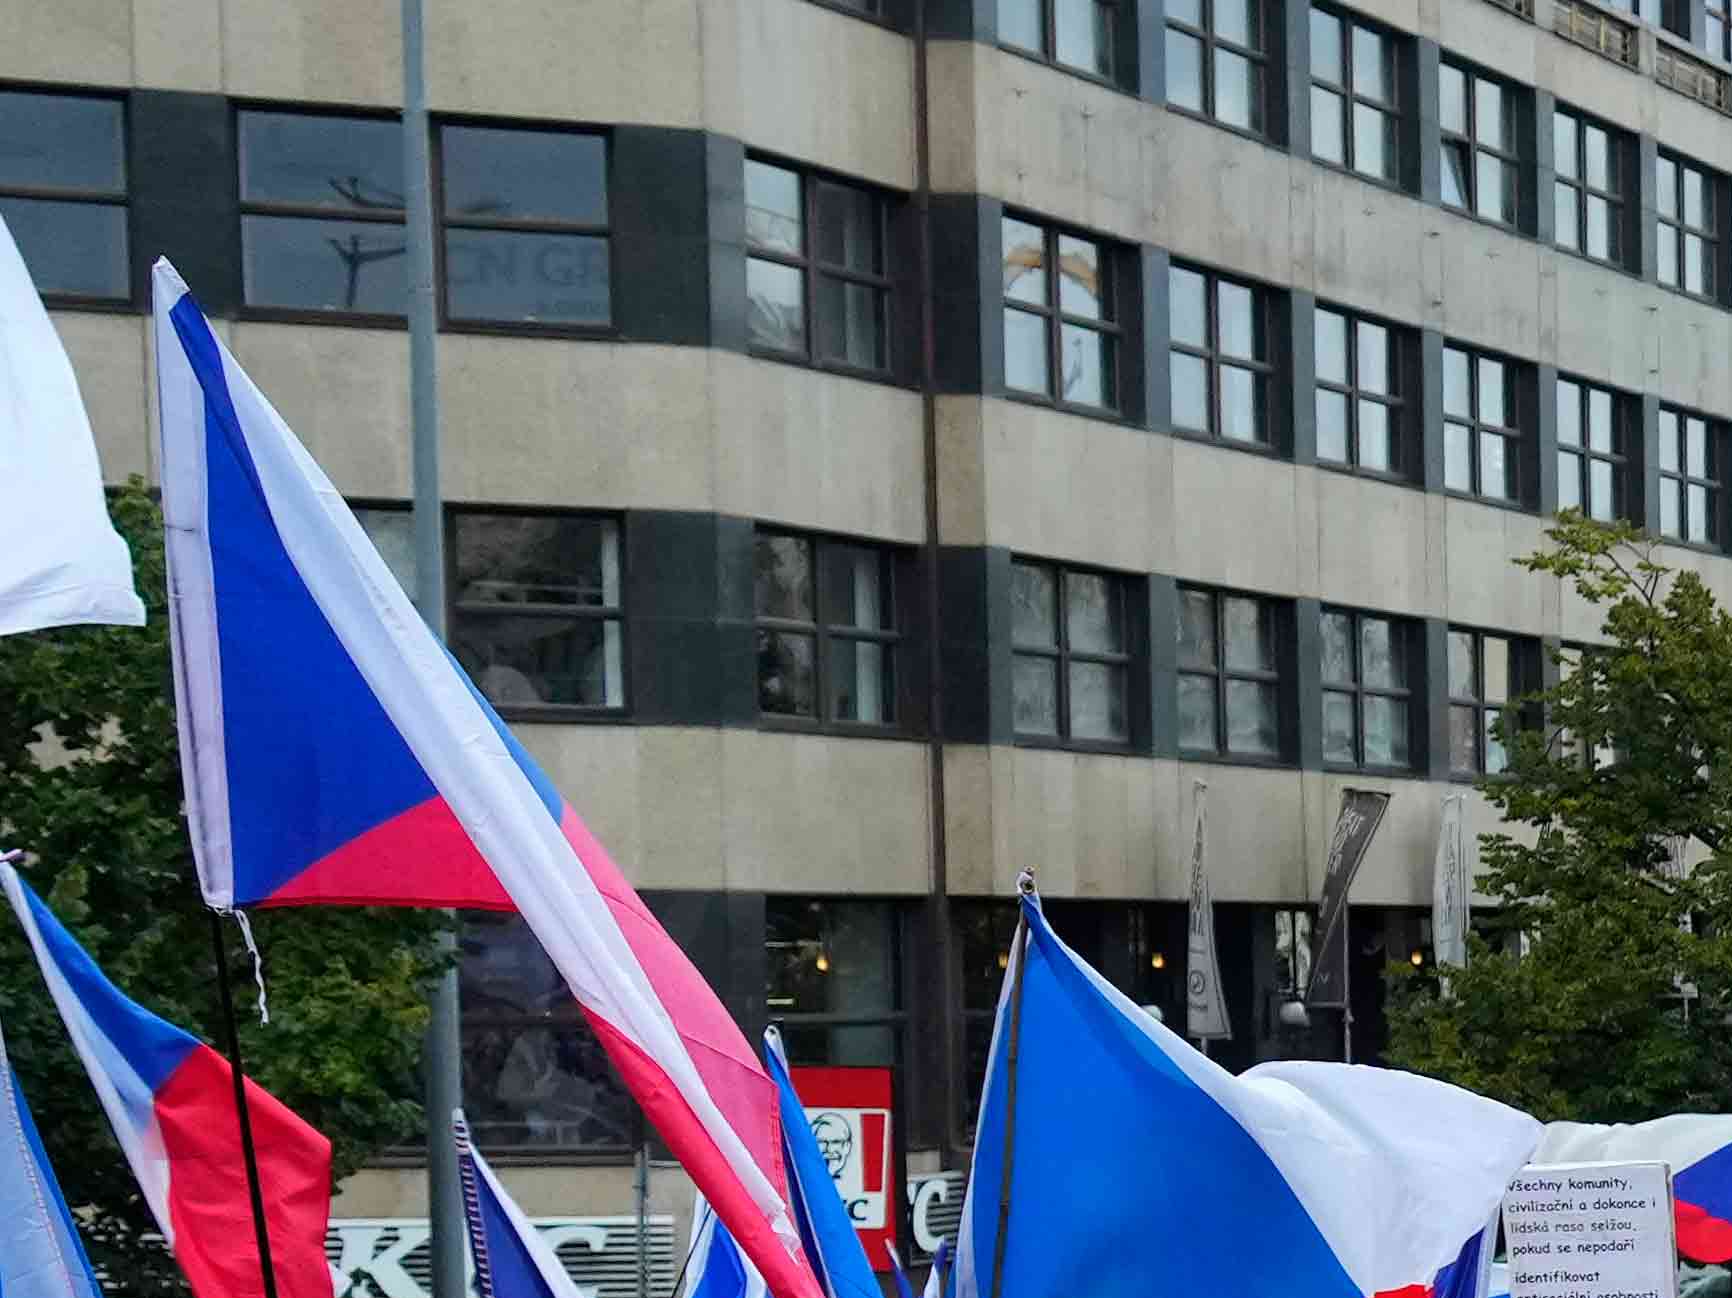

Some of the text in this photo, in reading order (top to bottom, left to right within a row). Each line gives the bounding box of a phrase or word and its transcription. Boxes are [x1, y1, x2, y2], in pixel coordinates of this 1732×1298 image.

[1508, 1177, 1633, 1192] Všechny komunity,
[1508, 1197, 1656, 1213] civilizační a dokonce i
[1510, 1221, 1550, 1234] lidská
[1555, 1222, 1585, 1232] rasa
[1512, 1240, 1635, 1256] pokud se nepodaří
[1514, 1271, 1600, 1284] identifikovat
